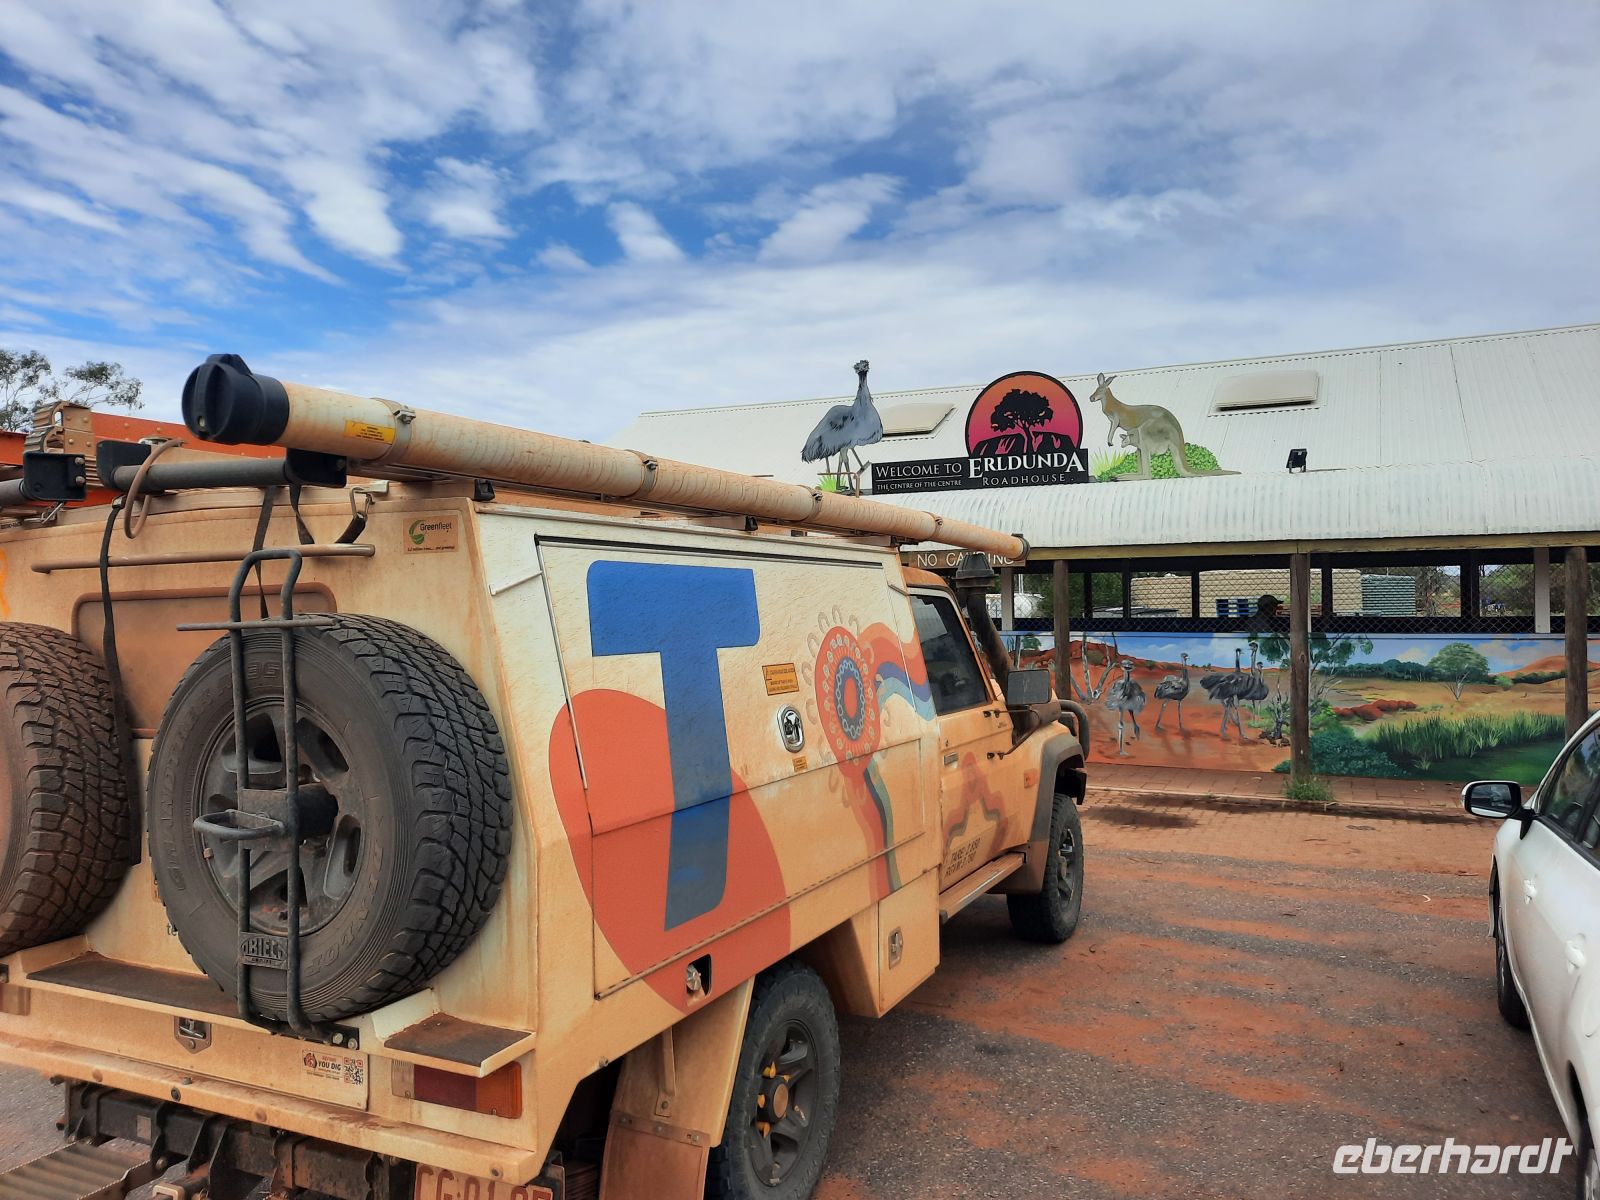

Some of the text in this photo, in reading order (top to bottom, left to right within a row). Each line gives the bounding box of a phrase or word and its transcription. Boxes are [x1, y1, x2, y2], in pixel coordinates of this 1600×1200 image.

[875, 462, 963, 478] WELCOME TO
[968, 450, 1086, 479] ERLDUNDA
[877, 479, 962, 491] THE CENTRE OF THE CENTRE
[982, 473, 1066, 487] ROADHOUSE
[420, 521, 453, 531] Greenfleet
[917, 552, 1014, 567] NO CAIN
[331, 1063, 342, 1071] DIG
